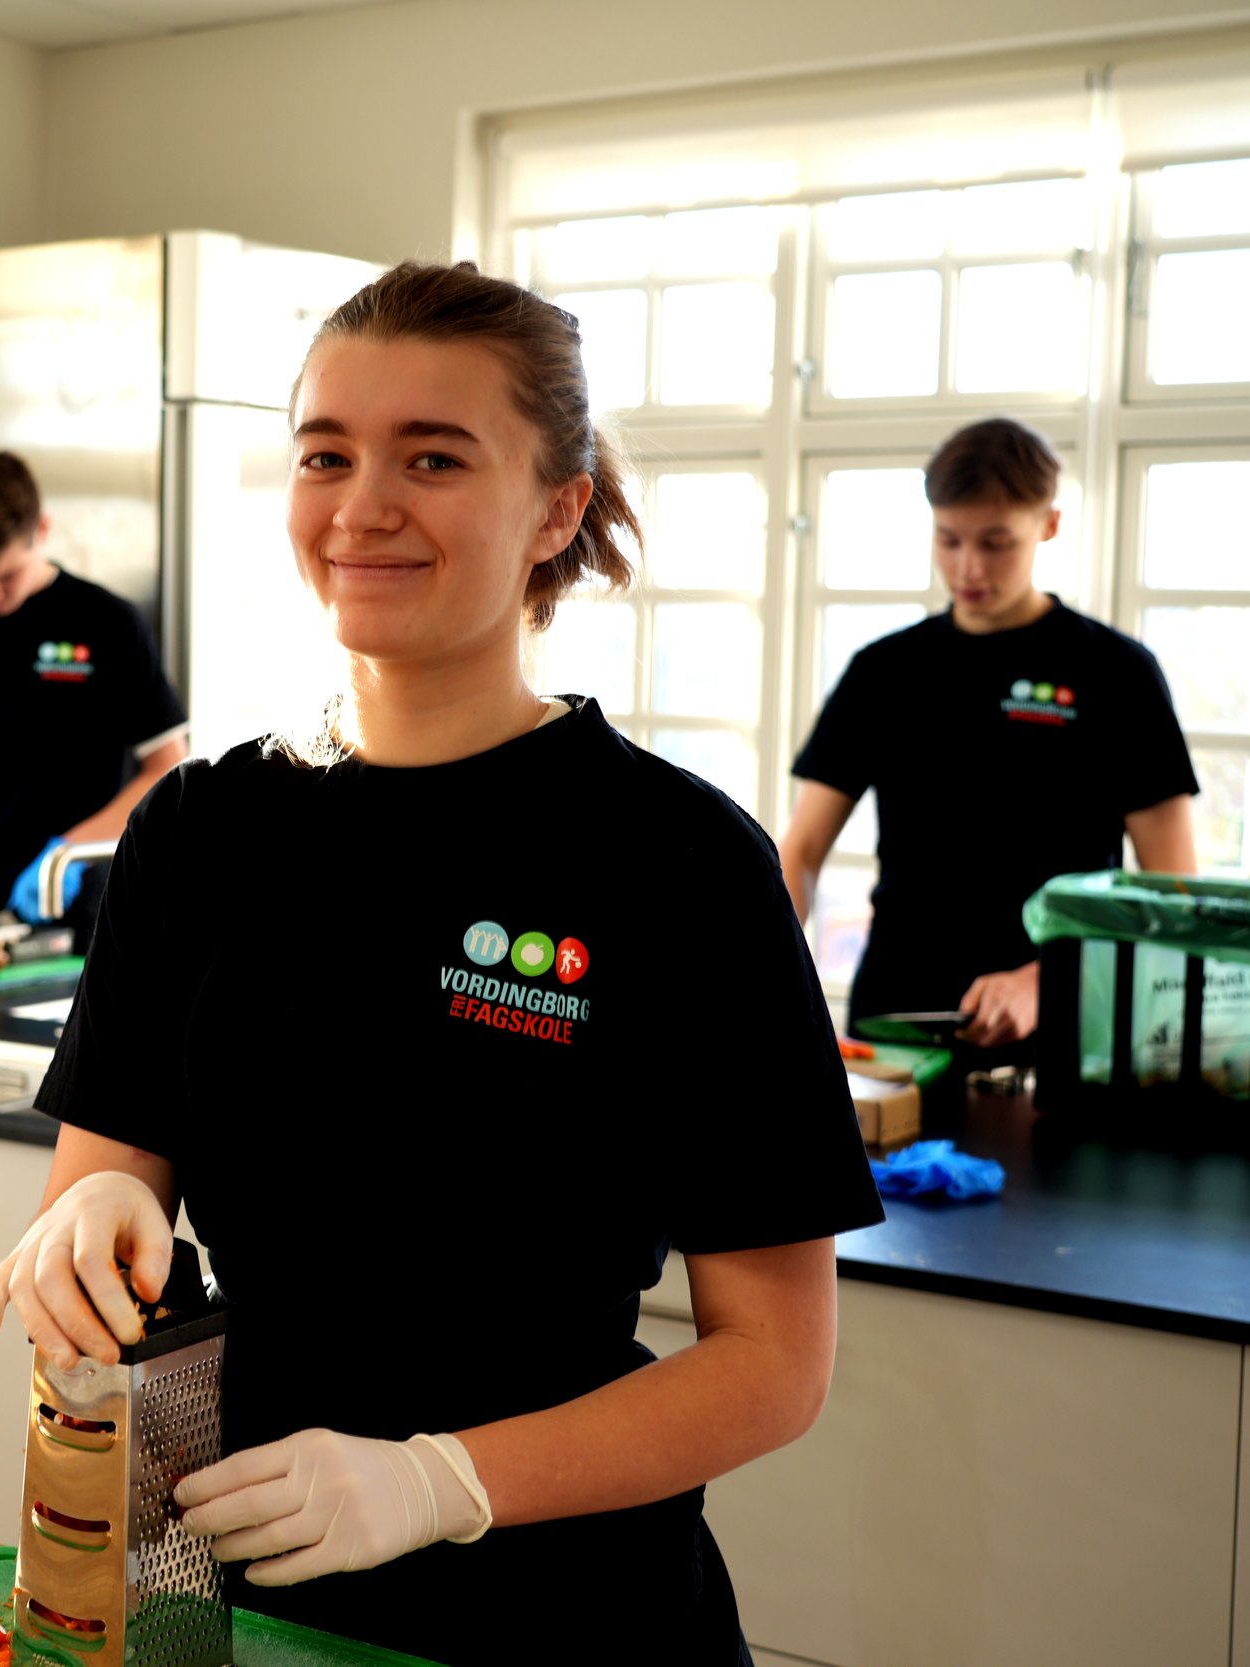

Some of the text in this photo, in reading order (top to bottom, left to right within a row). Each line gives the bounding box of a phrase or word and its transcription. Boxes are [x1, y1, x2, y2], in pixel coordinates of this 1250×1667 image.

[440, 966, 591, 1022] VORDINGBORG
[450, 994, 573, 1045] FRI FAGSKOLE
